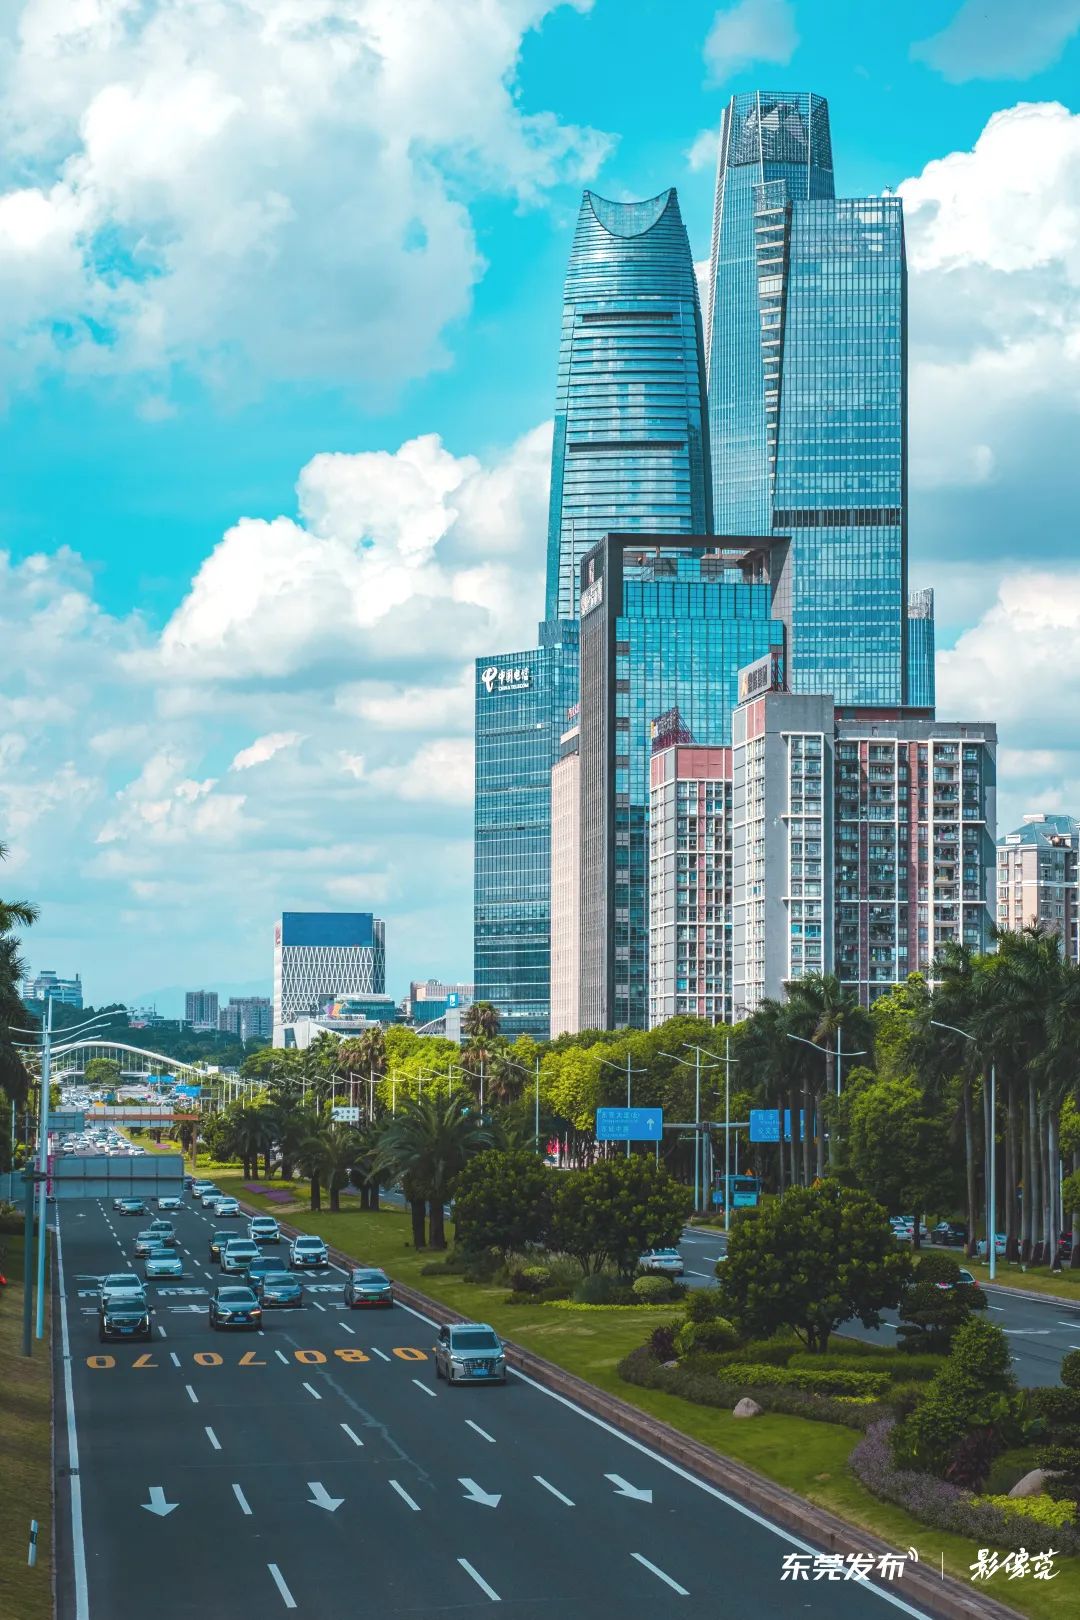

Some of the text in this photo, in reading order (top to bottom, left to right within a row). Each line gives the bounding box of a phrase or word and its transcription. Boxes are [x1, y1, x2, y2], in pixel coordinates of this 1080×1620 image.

[498, 667, 529, 685] 中国电信
[86, 1354, 159, 1369] 70
[193, 1352, 267, 1366] 70
[293, 1348, 371, 1364] 80
